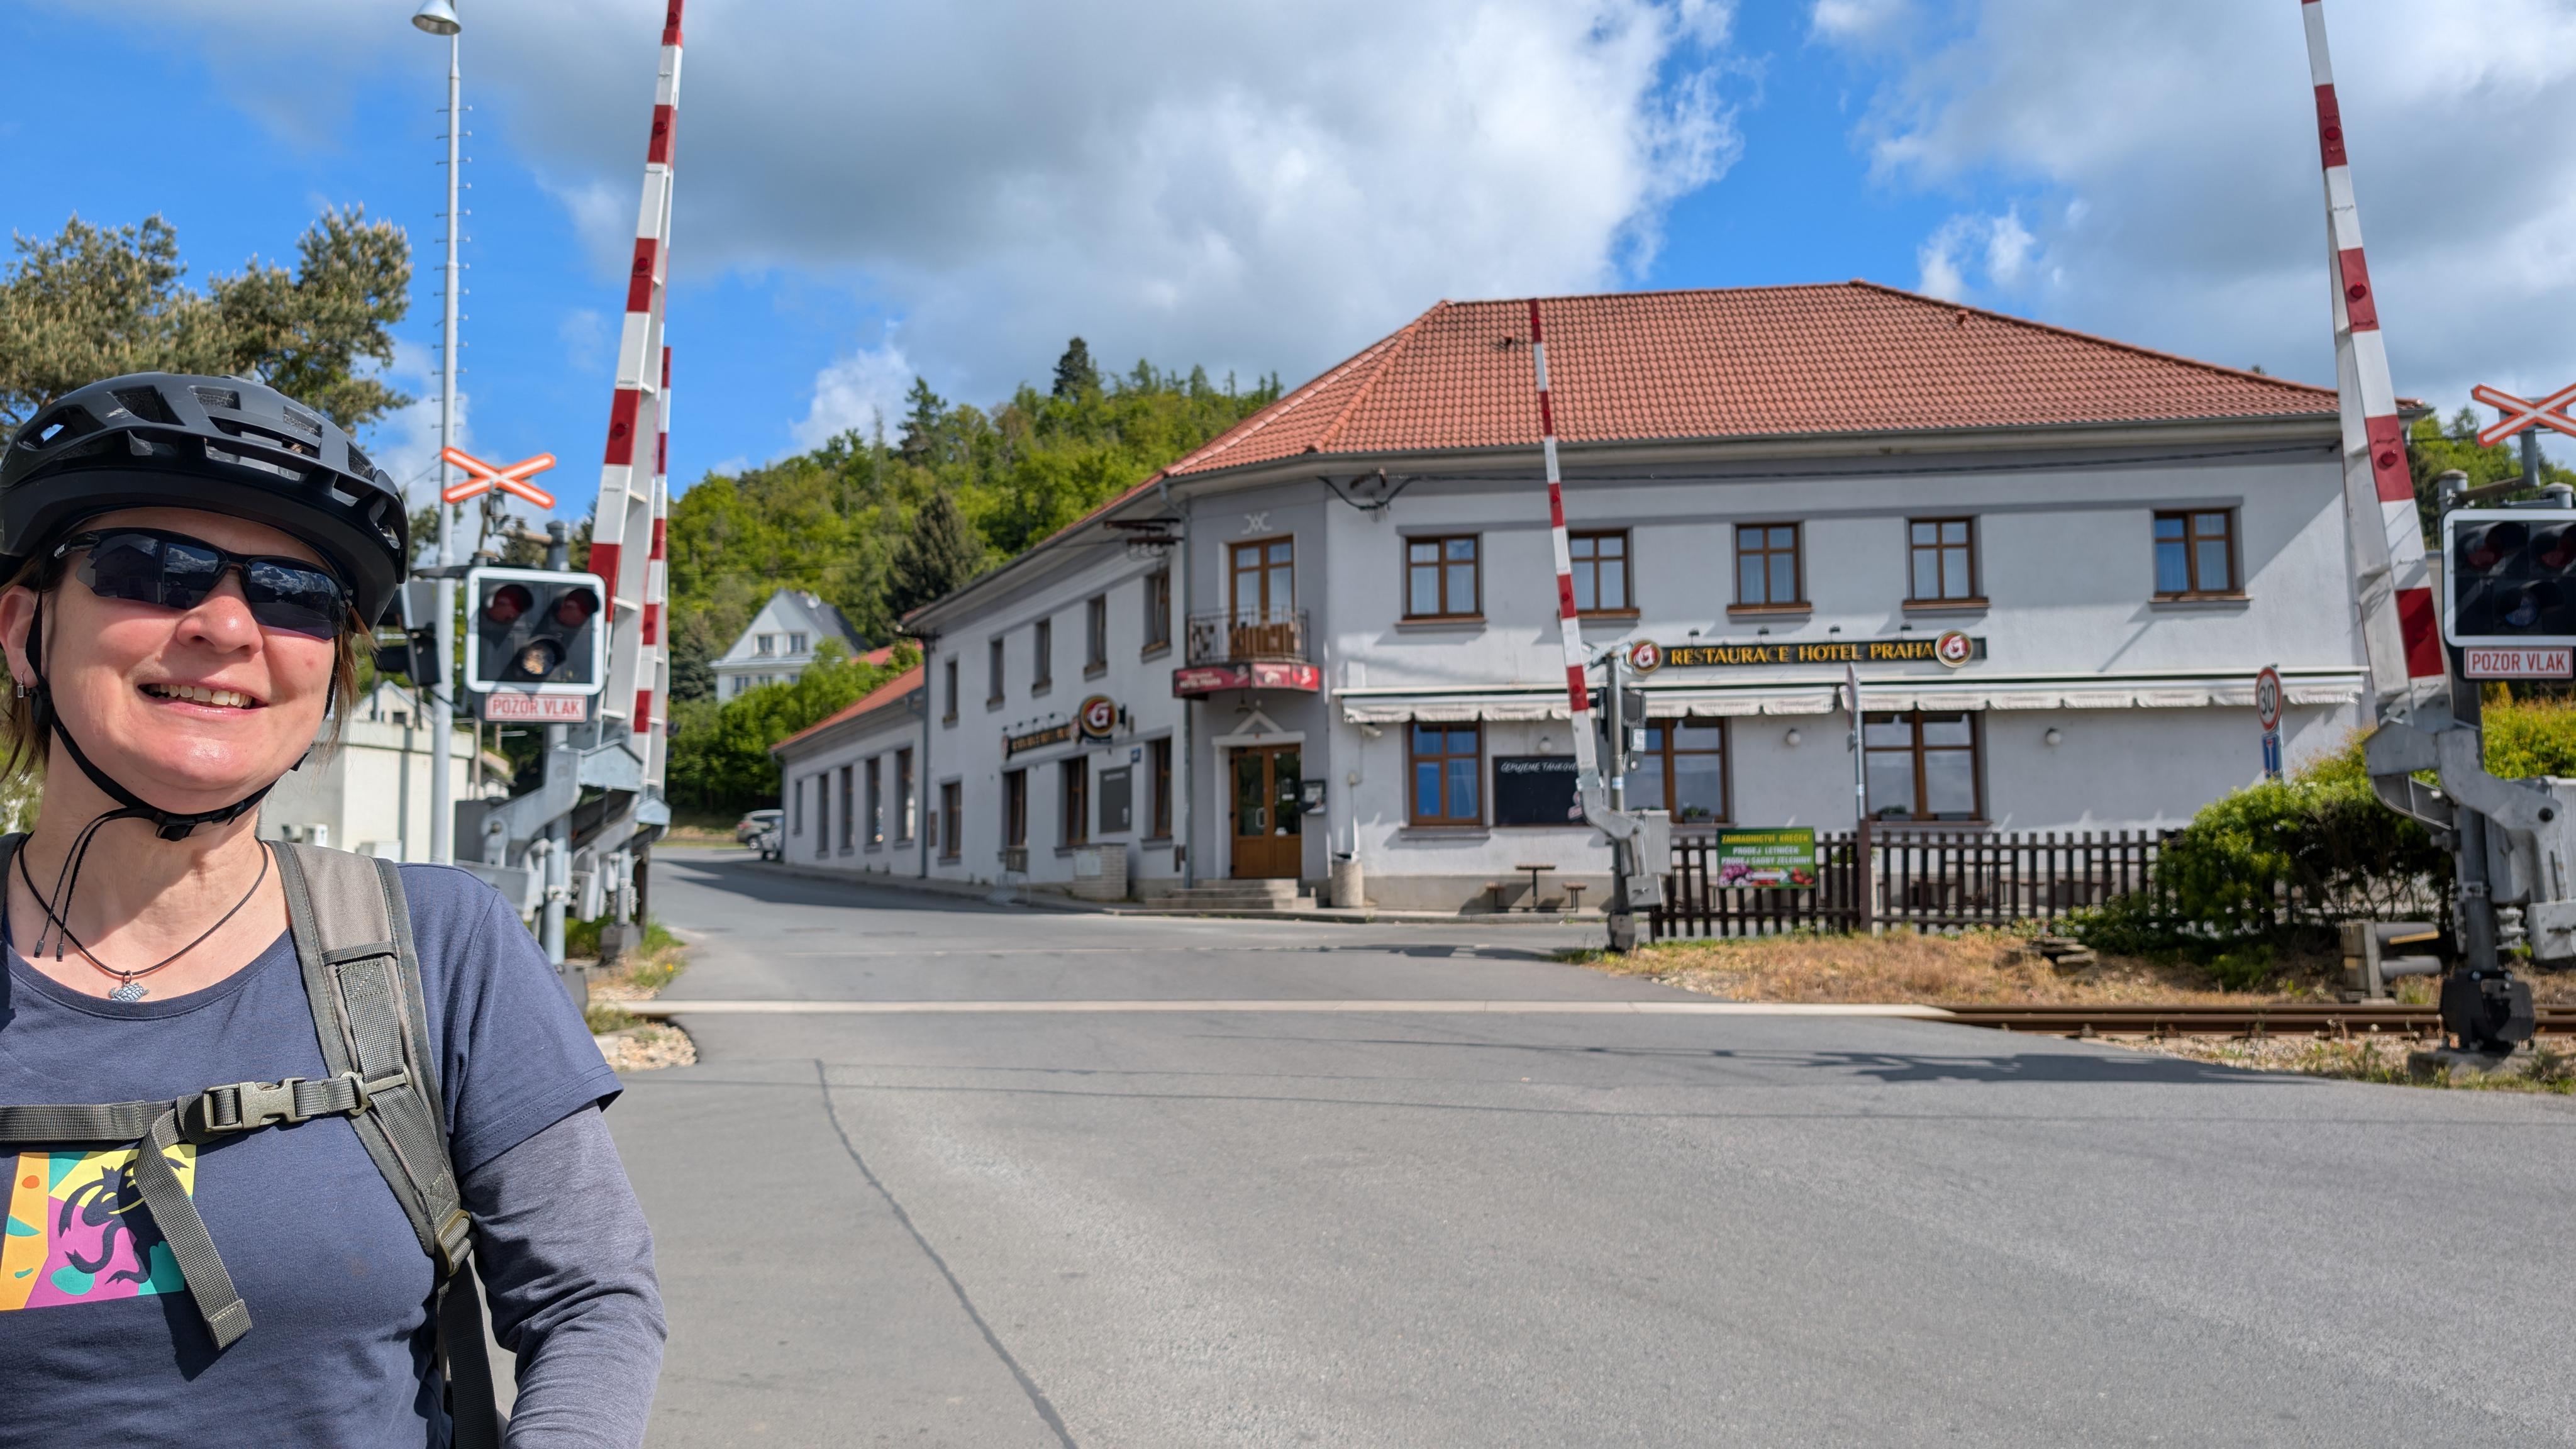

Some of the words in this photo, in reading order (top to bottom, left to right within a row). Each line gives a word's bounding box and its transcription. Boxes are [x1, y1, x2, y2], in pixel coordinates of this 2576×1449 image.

[54, 543, 65, 557] uvex
[1671, 646, 1790, 665] RESTAURACE
[1799, 643, 1862, 661] HOTEL
[1870, 641, 1934, 659] PRAHA
[2472, 653, 2521, 671] POZOR
[2526, 653, 2565, 671] VLAK
[492, 699, 538, 714] POZOR
[543, 700, 580, 714] VLAK
[2260, 684, 2275, 715] 30
[1733, 846, 1761, 855] PRODEJ
[1765, 845, 1799, 855] LETNIČEK
[1721, 857, 1749, 865] PRODEJ
[1777, 856, 1811, 865] ZELENINY
